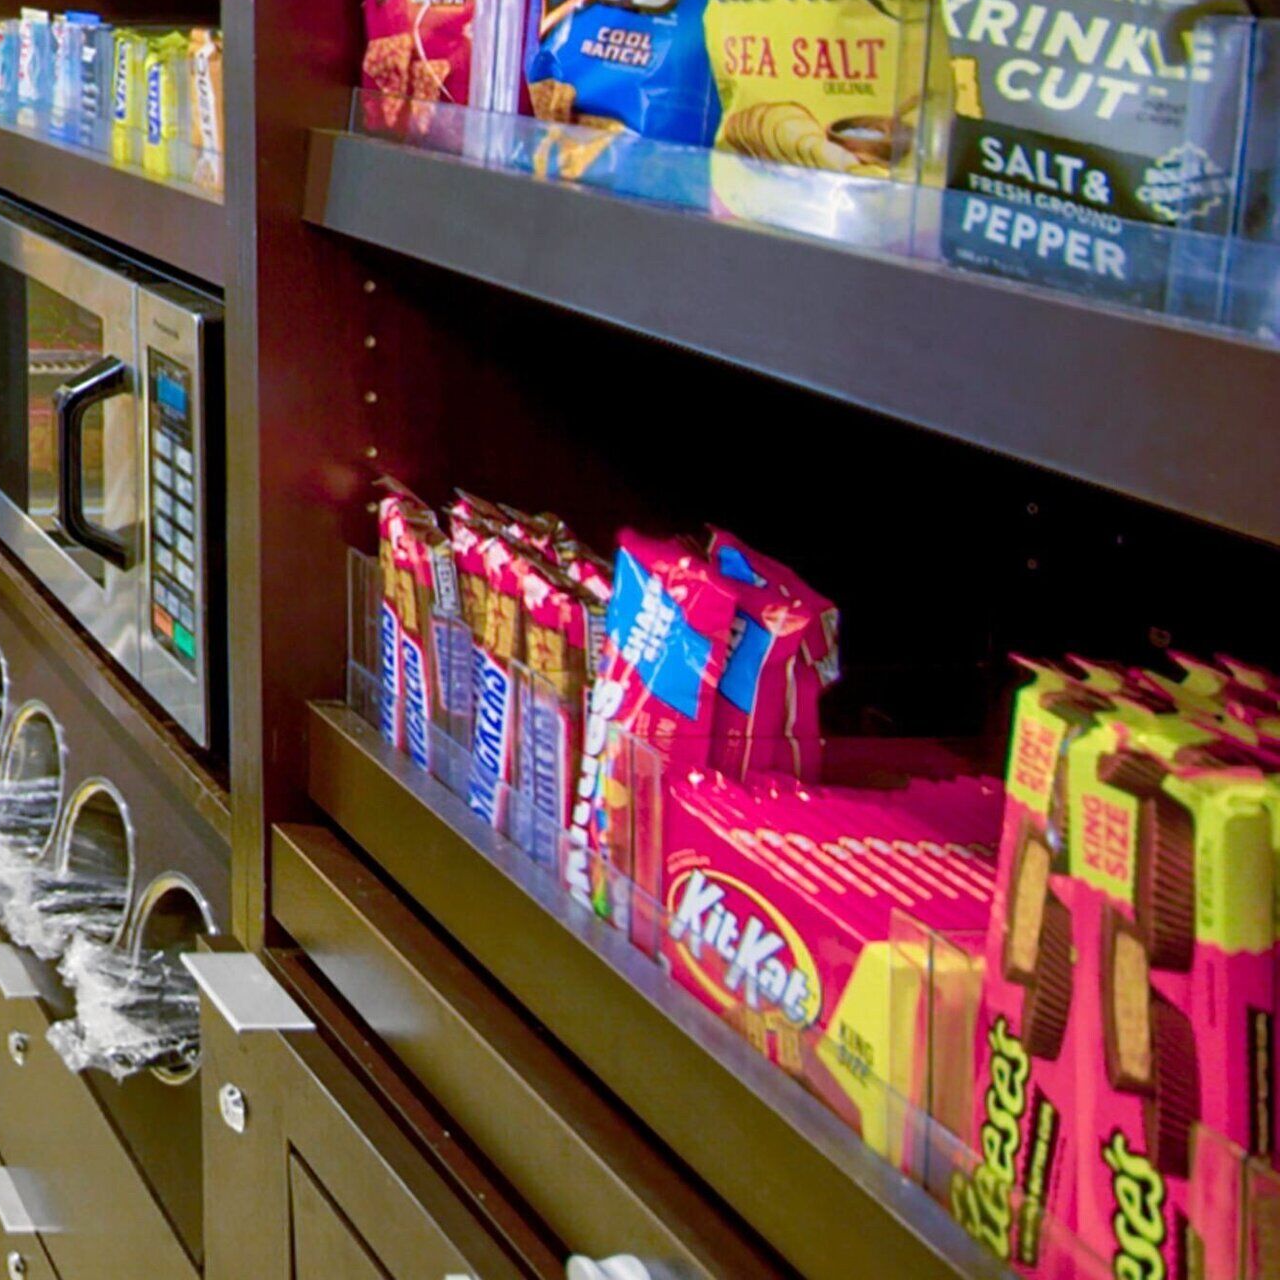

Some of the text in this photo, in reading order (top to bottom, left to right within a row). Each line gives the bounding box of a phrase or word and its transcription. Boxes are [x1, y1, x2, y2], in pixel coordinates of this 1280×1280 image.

[580, 39, 653, 67] RANCH
[597, 26, 653, 50] COOL
[724, 35, 886, 81] SEA SALT
[996, 58, 1139, 120] CUT
[968, 173, 1122, 236] FRESH GROUND
[962, 197, 1126, 280] PEPPER
[1082, 793, 1104, 871] KING
[1104, 802, 1132, 883] SIZE
